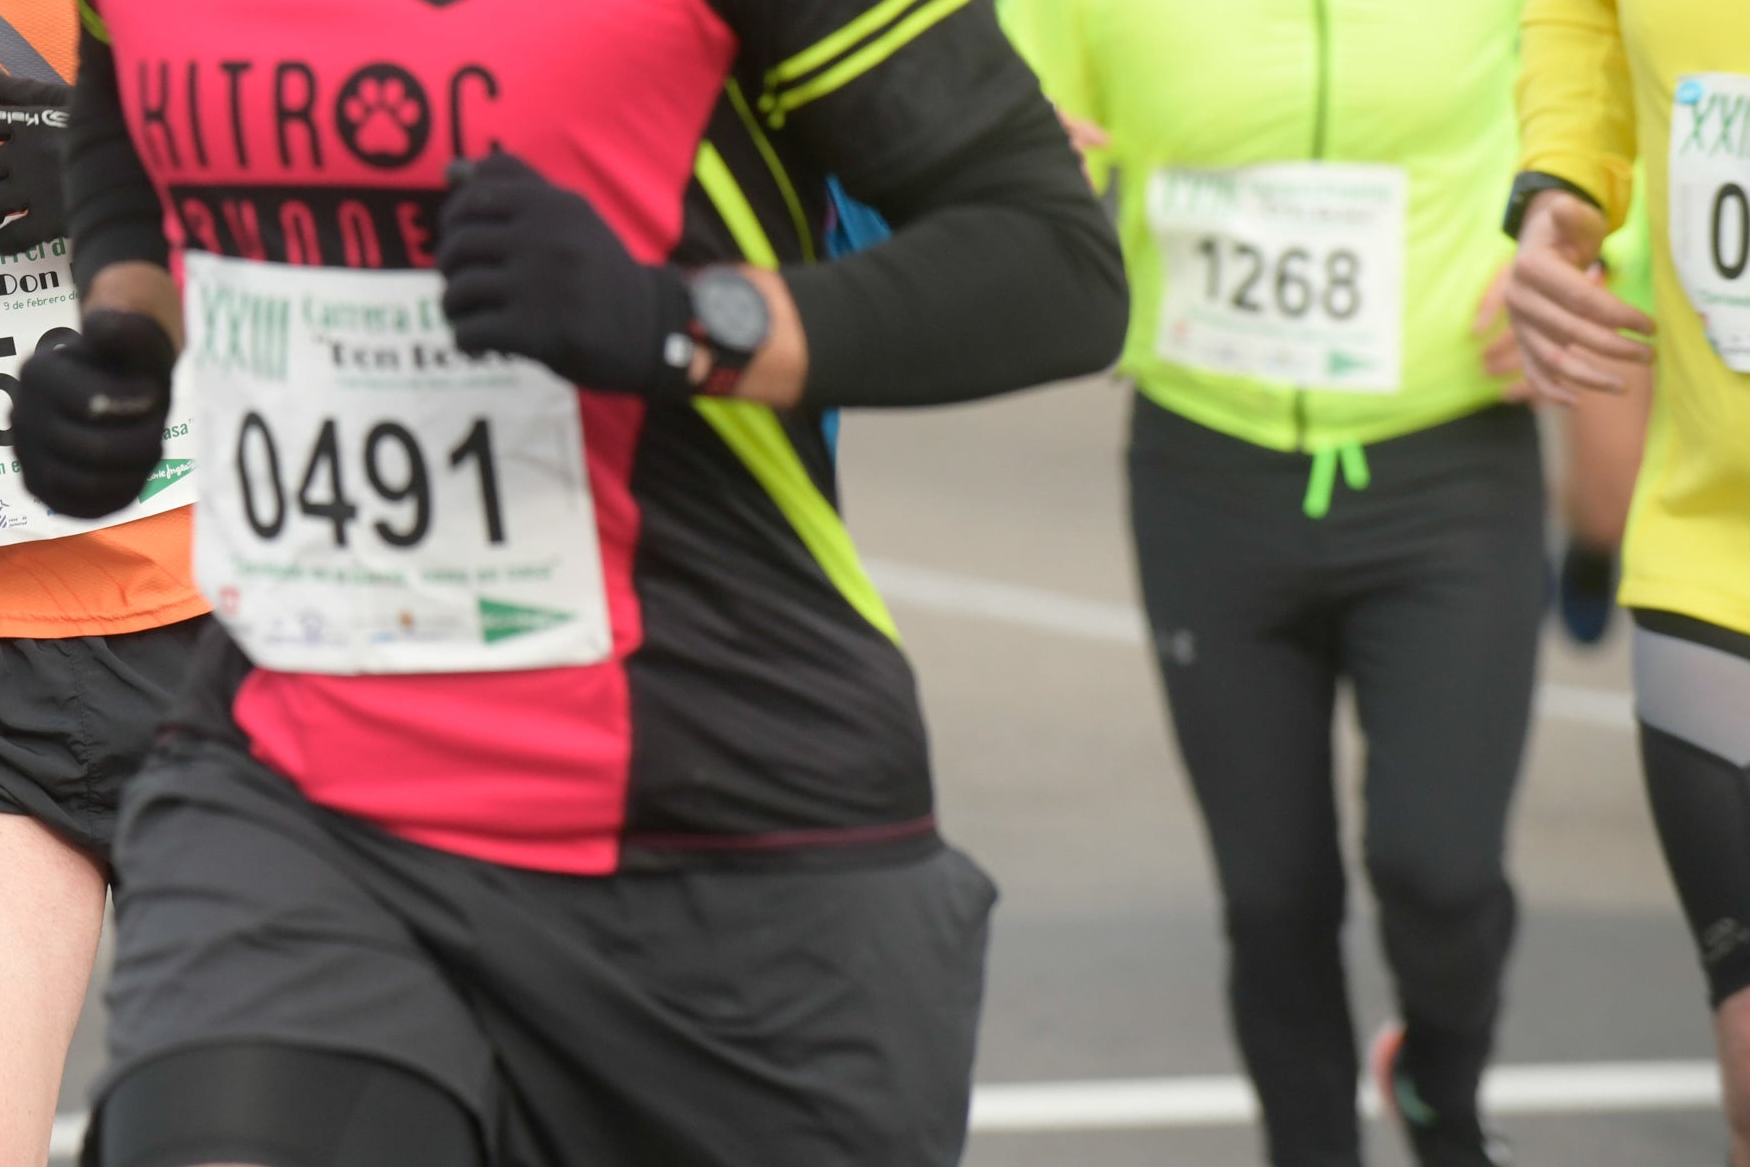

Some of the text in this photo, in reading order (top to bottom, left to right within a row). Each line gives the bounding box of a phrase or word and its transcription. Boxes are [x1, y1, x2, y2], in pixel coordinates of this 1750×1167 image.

[178, 198, 435, 269] RUNNE
[1710, 181, 1750, 280] 0
[3, 301, 10, 311] 9
[12, 301, 24, 310] de
[26, 294, 66, 307] febrero
[1197, 236, 1364, 321] 1268
[162, 418, 194, 440] asa"
[11, 460, 21, 473] e
[235, 411, 507, 547] 0491
